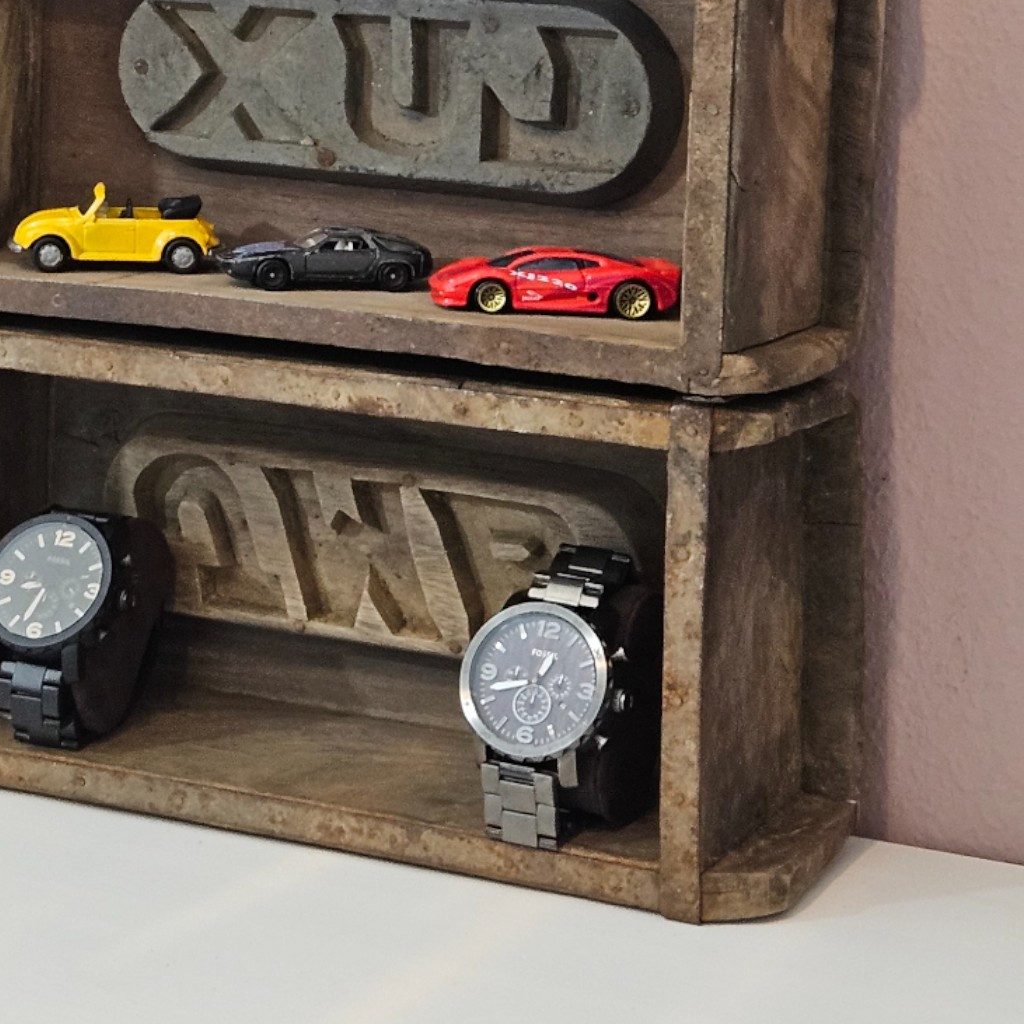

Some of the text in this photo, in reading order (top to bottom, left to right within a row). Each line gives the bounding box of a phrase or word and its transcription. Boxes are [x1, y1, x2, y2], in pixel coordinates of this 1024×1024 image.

[54, 530, 76, 548] 12
[0, 569, 16, 585] 9
[83, 583, 101, 600] 3
[26, 622, 43, 639] 6
[537, 621, 561, 640] 12
[480, 663, 497, 680] 9
[577, 683, 594, 700] 3
[516, 727, 534, 744] 6
